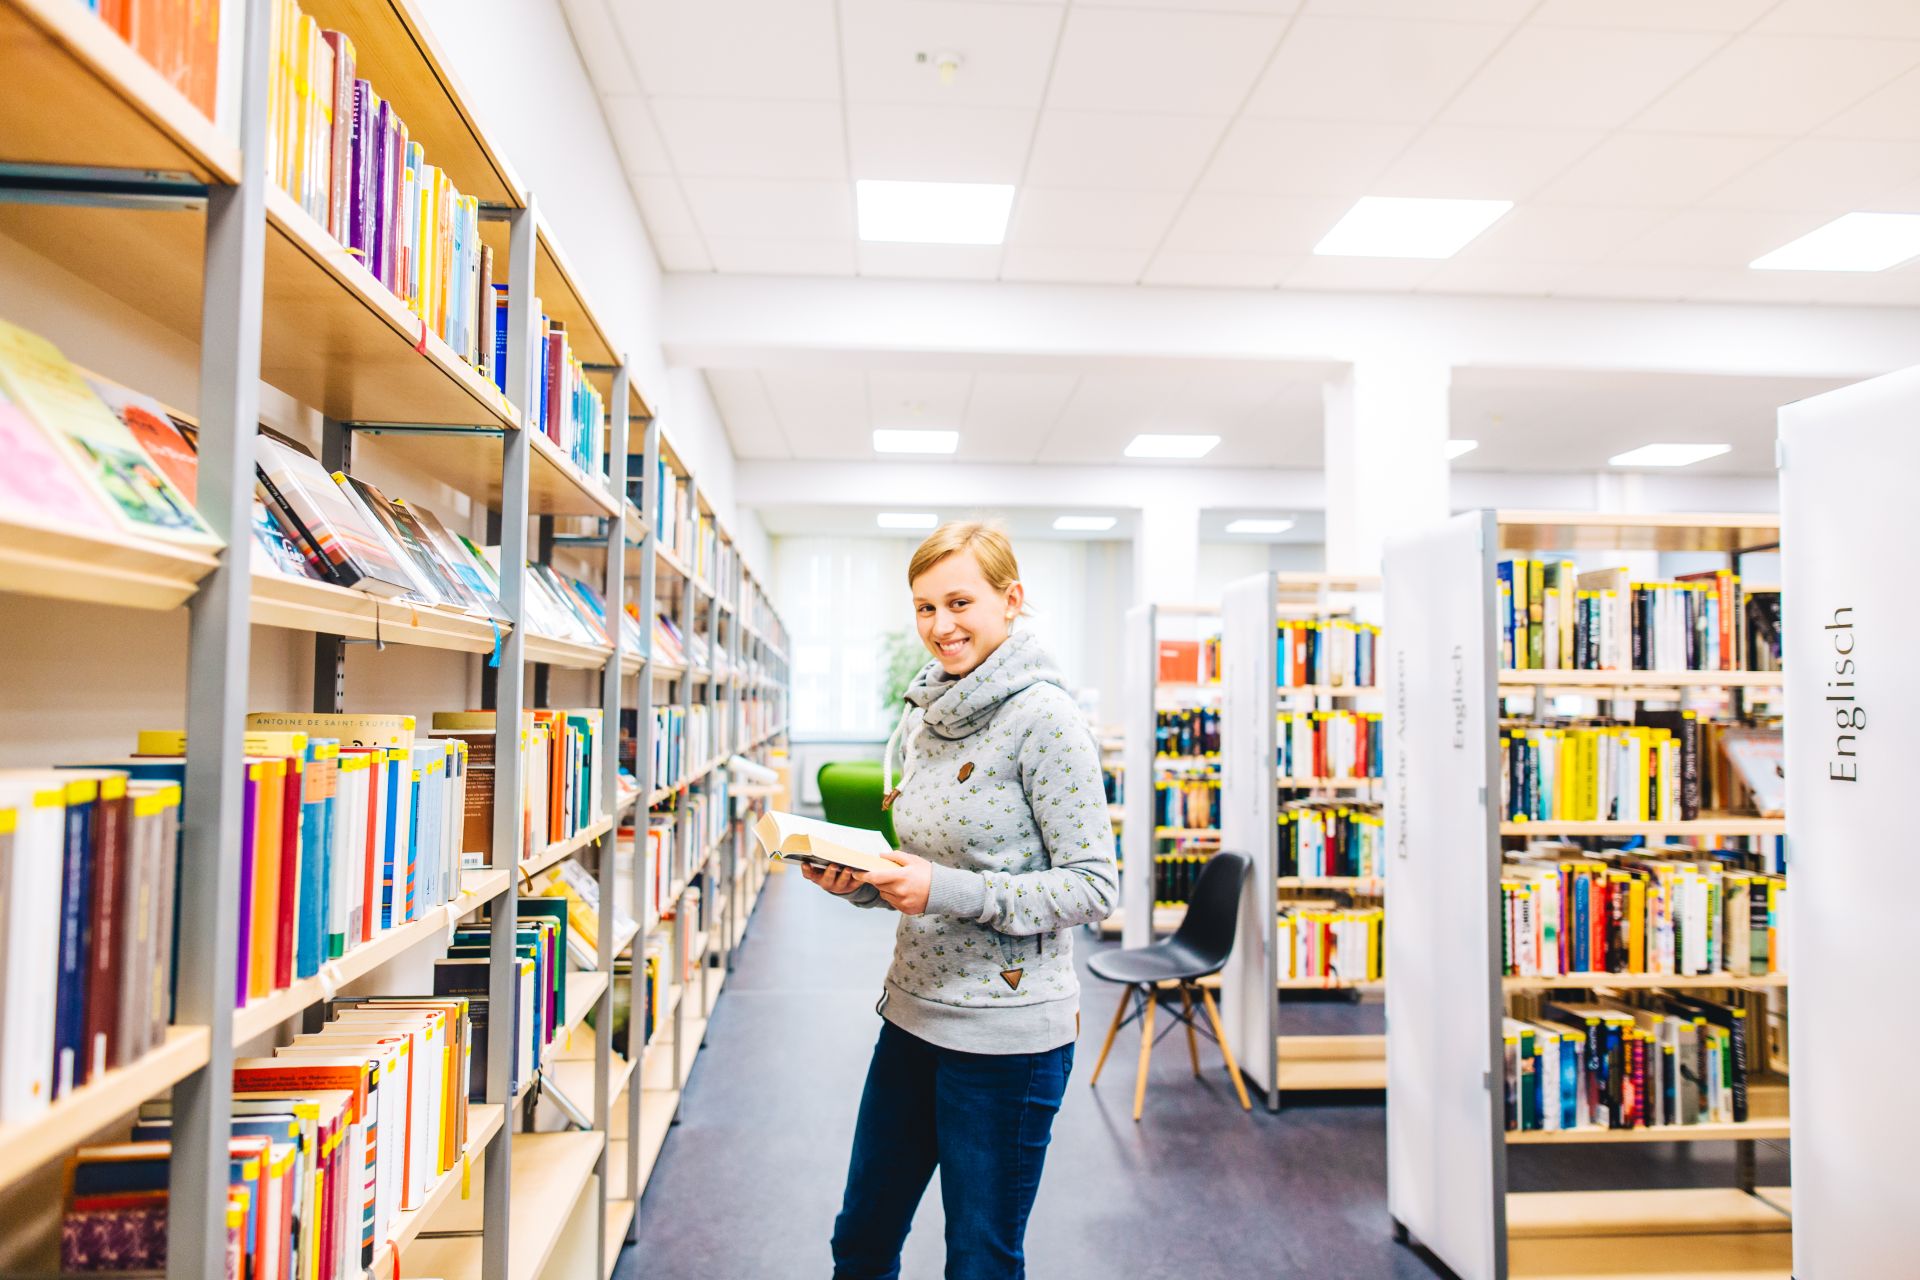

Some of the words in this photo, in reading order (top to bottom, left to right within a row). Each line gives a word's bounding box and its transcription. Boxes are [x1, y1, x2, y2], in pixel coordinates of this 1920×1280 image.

[256, 718, 302, 726] ANTOINE
[1397, 650, 1407, 745] Autoren
[1450, 644, 1467, 750] Englisch
[1824, 607, 1867, 782] Englisch
[1396, 749, 1409, 860] Deutsche
